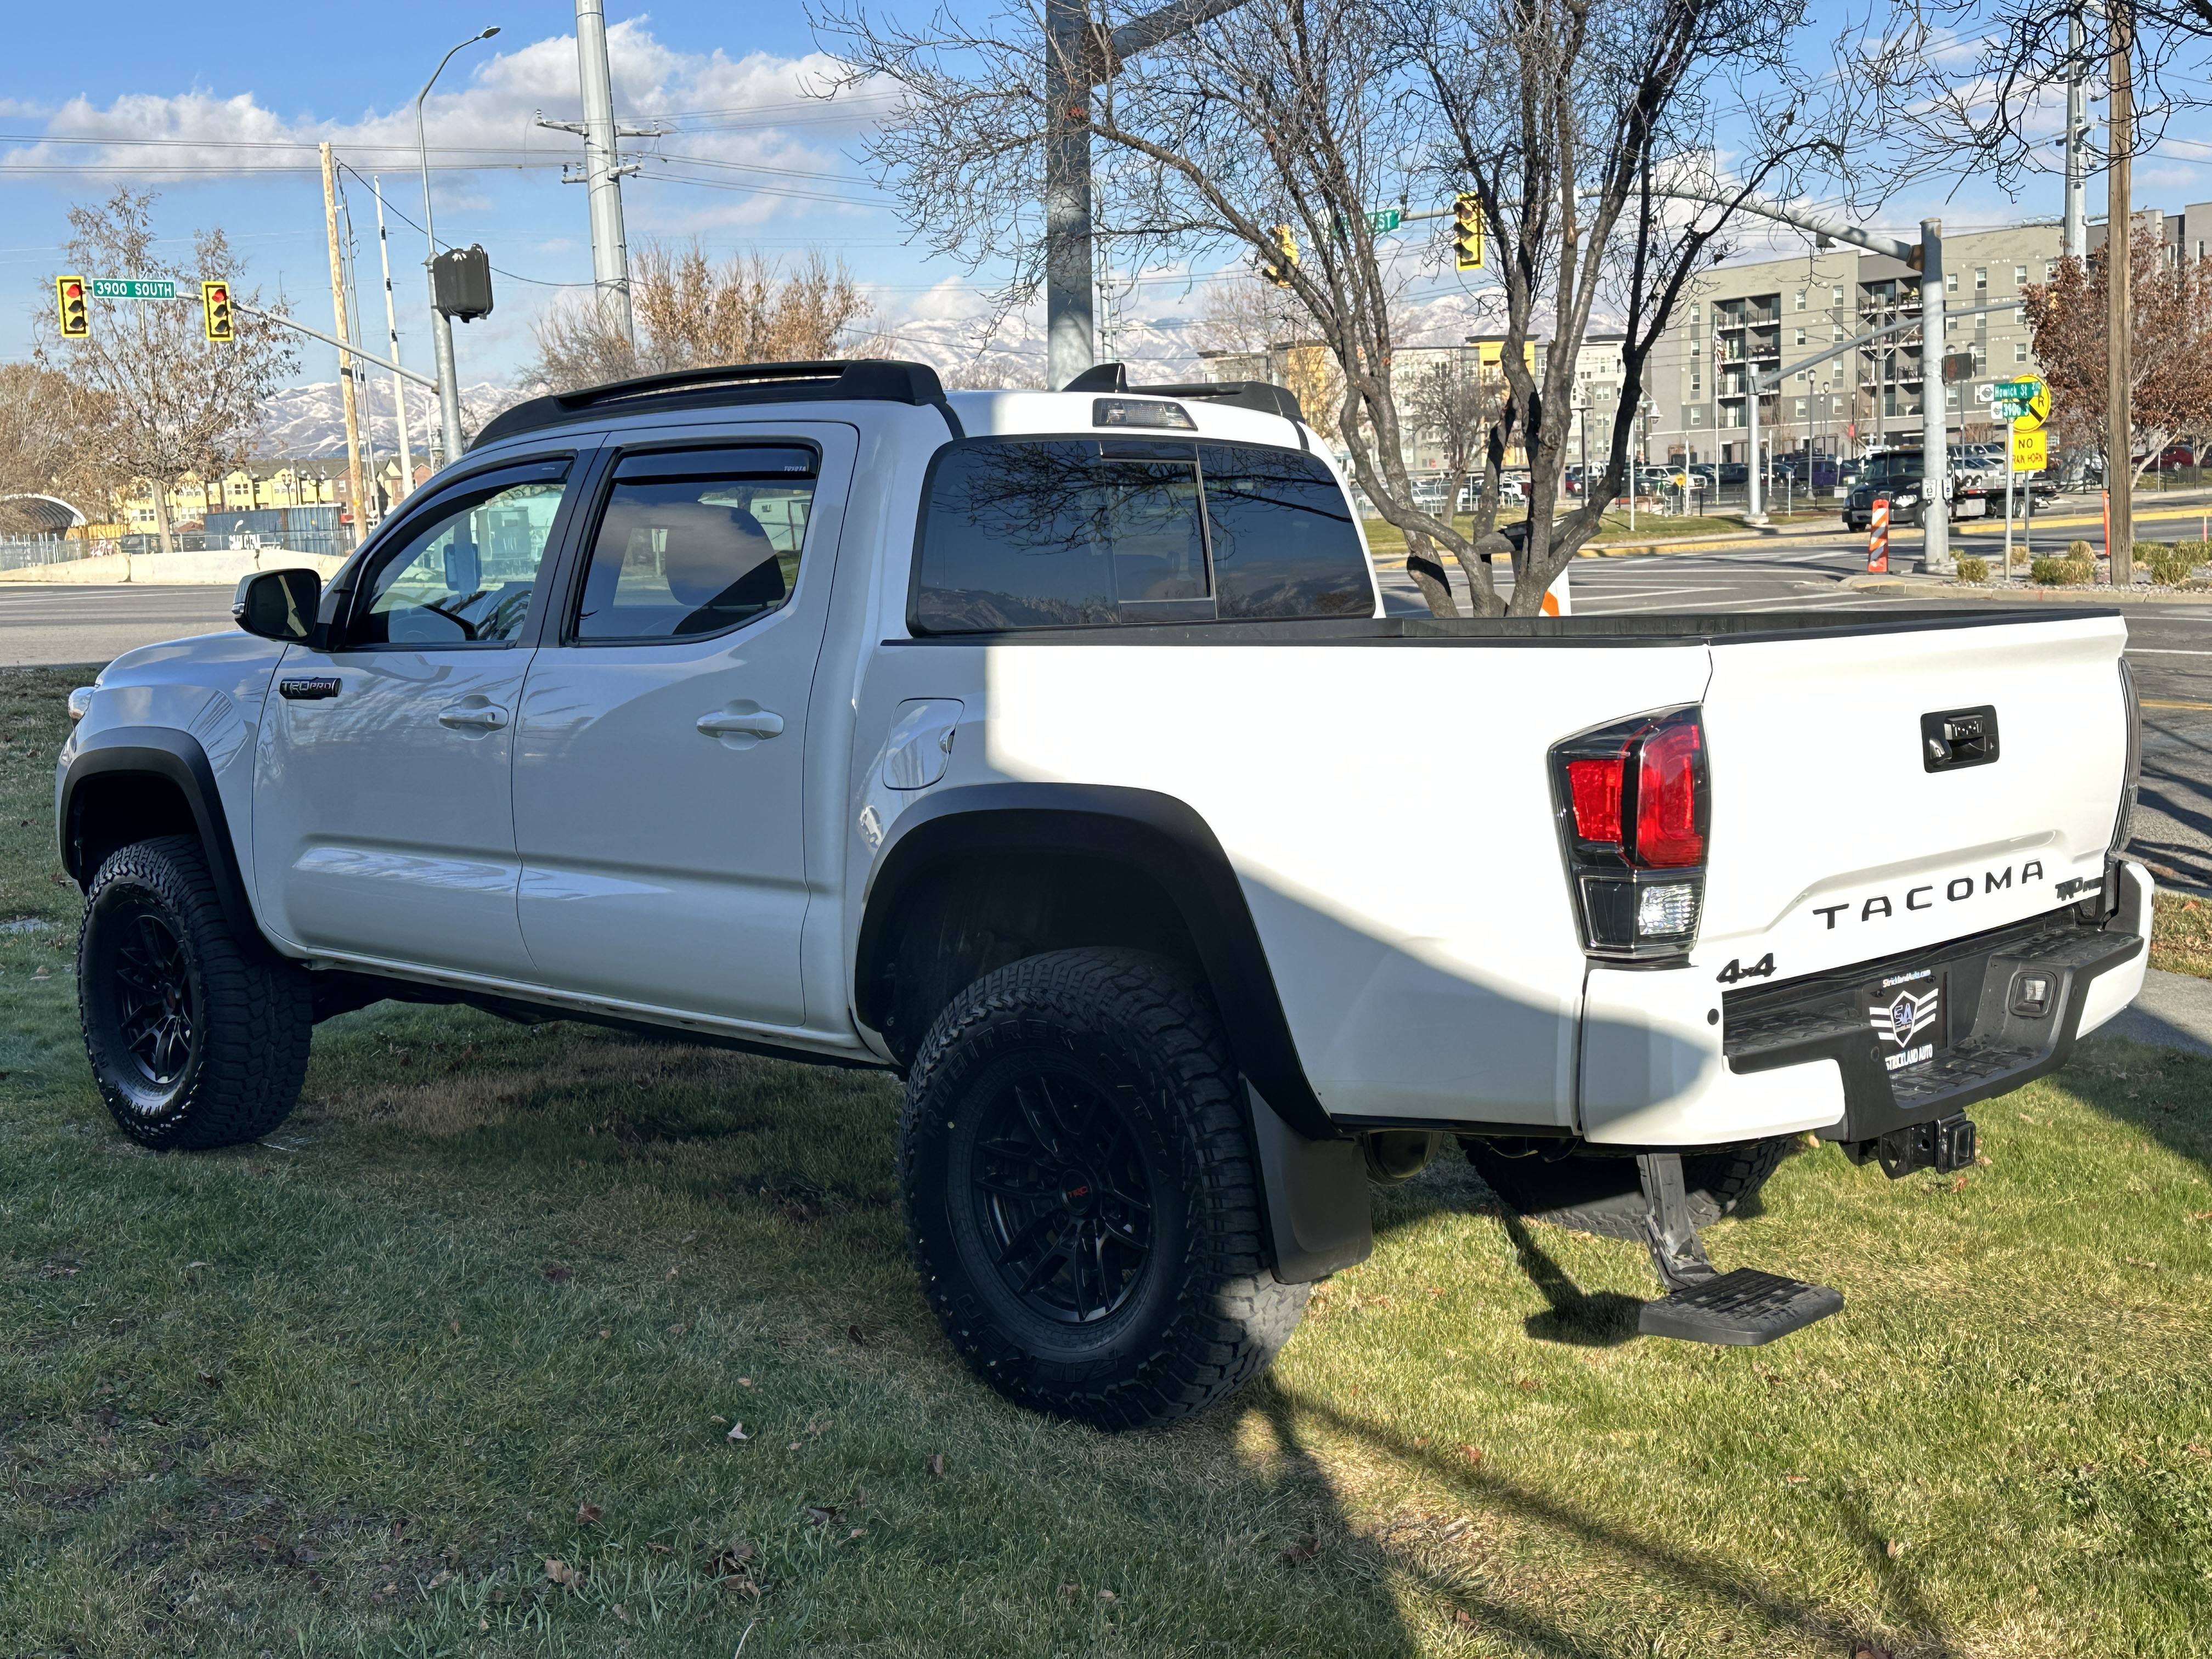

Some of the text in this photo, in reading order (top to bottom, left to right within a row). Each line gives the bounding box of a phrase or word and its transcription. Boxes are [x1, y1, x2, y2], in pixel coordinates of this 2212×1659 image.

[96, 281, 172, 297] 3900 SOUTH
[2018, 438, 2033, 449] NO
[281, 680, 309, 694] TRD
[1813, 860, 2044, 929] TACOMA
[1918, 1043, 1933, 1062] AUTO
